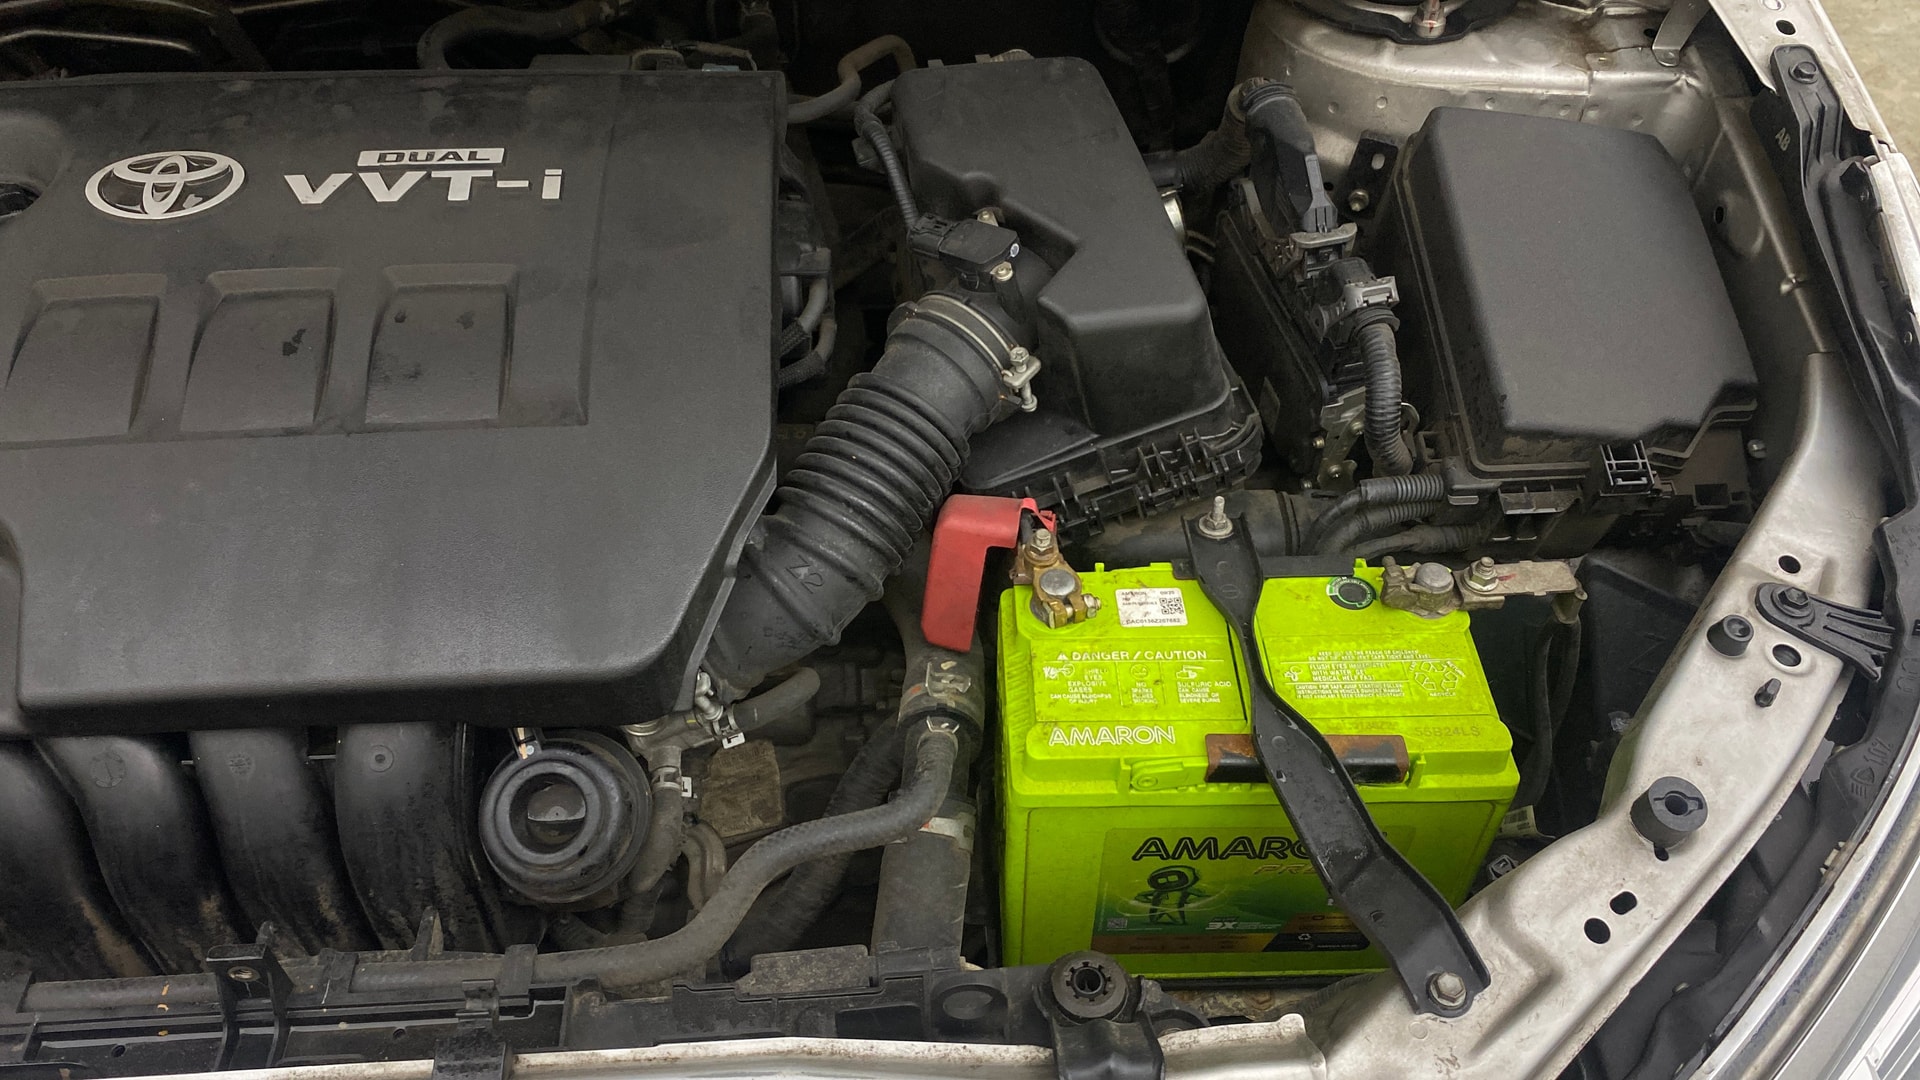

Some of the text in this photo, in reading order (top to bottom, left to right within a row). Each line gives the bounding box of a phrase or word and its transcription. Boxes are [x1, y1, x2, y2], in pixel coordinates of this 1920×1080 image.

[376, 150, 491, 164] DUAL
[283, 168, 563, 205] VVT-i
[784, 554, 825, 595] Z2
[1072, 650, 1207, 660] DANGER / CAUTION
[1049, 726, 1176, 746] AMARON
